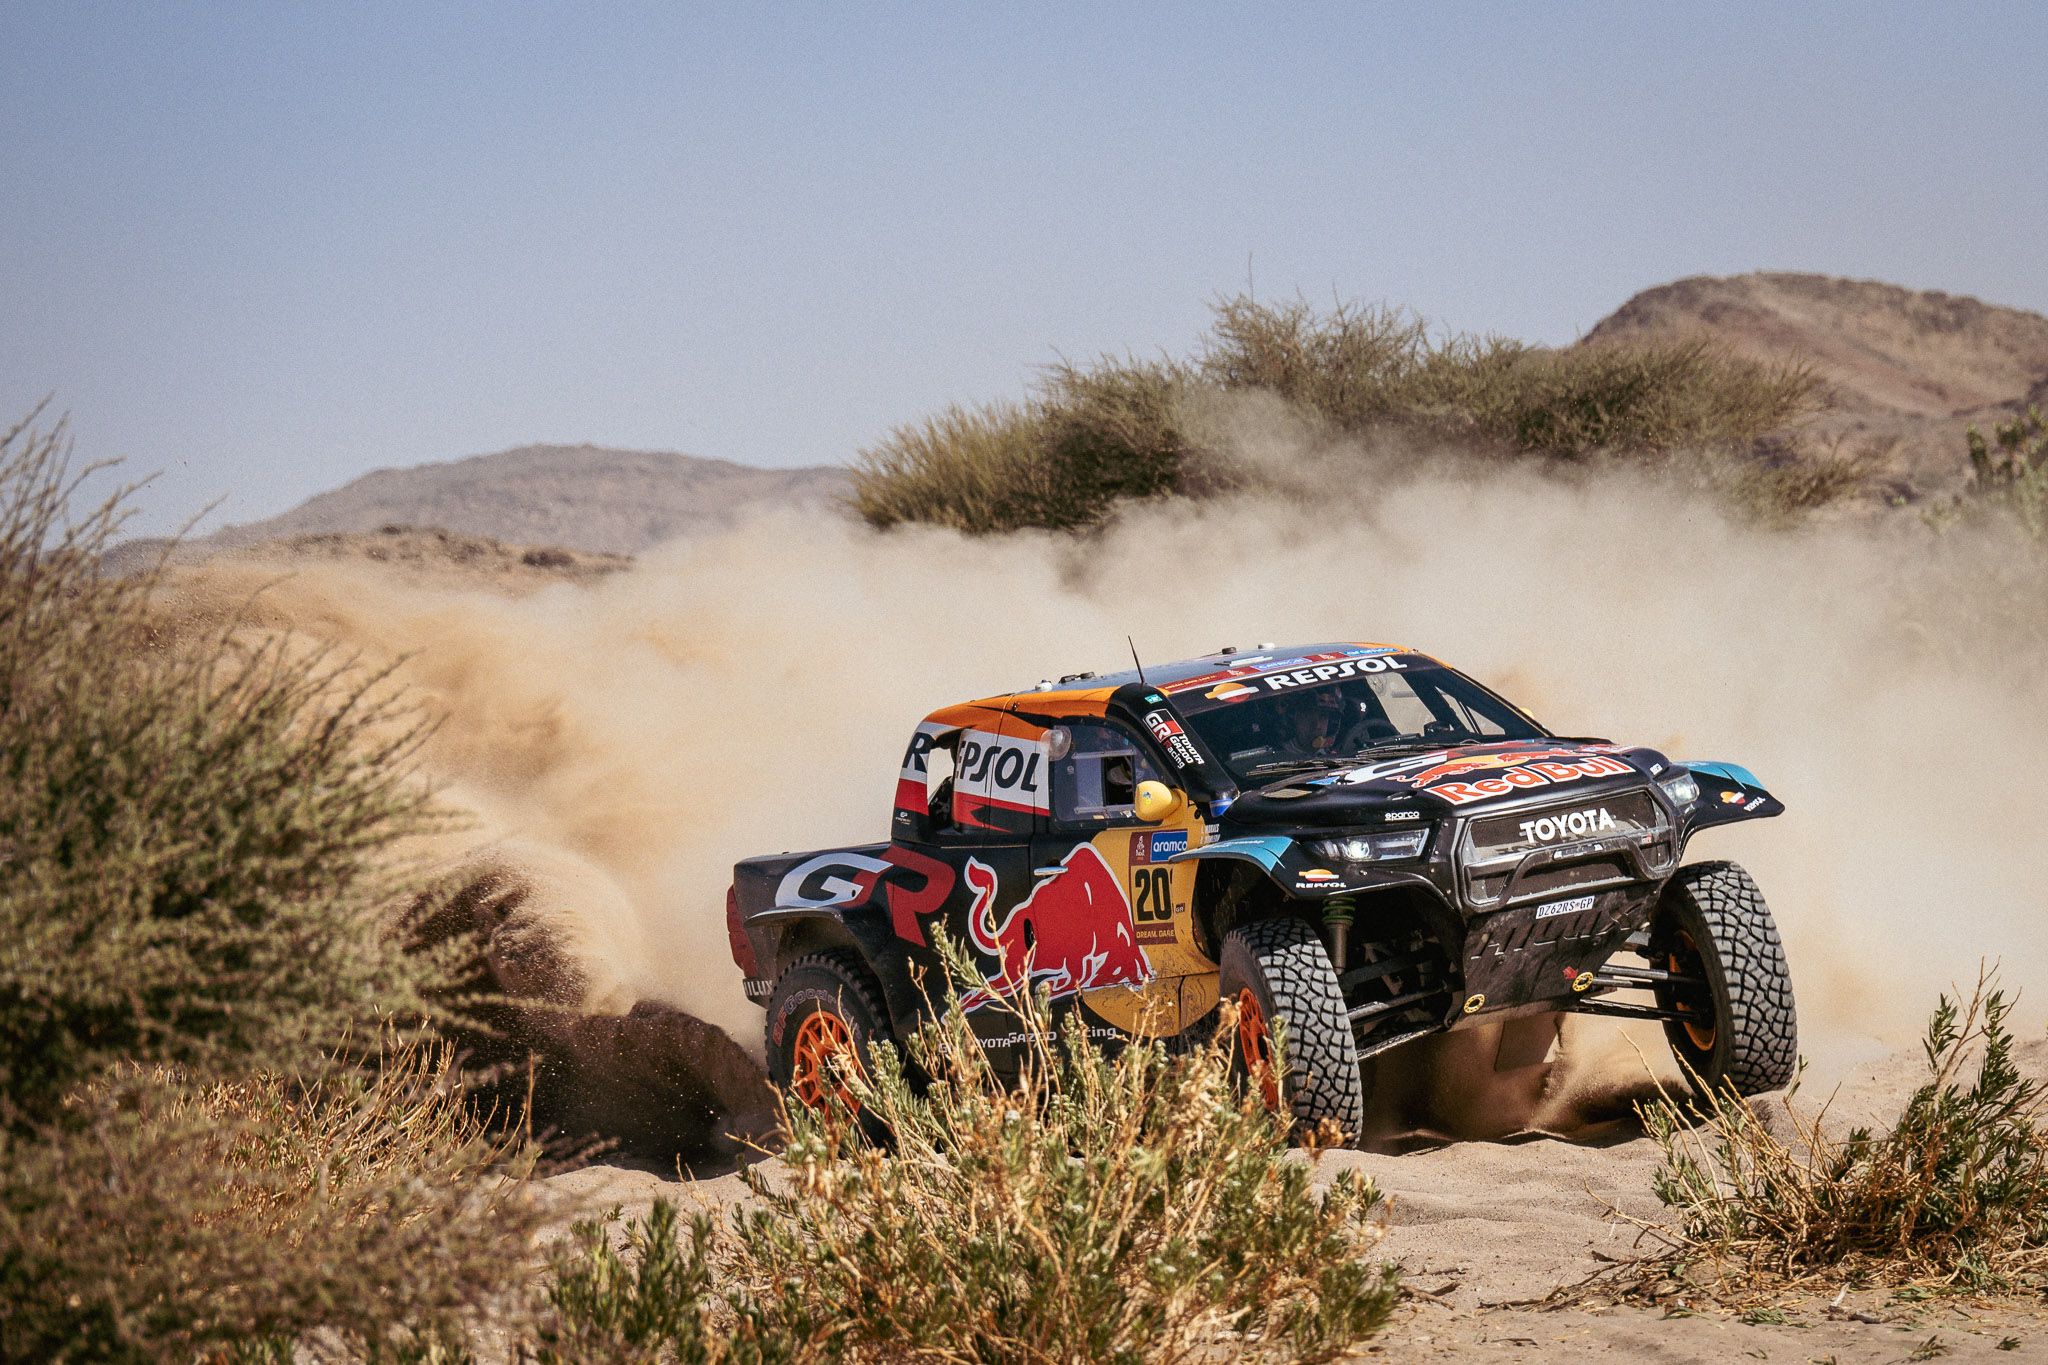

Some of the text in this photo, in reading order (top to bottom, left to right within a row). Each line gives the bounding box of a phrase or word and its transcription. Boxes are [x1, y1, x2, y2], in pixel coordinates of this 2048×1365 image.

[1263, 656, 1408, 691] REPSOL
[1145, 712, 1171, 740] GR
[1163, 739, 1186, 769] Racing
[1169, 735, 1194, 764] GAZOO
[1178, 734, 1205, 765] TOYOTA
[1423, 756, 1636, 805] Red Bull
[1518, 807, 1617, 843] TOYOTA
[1153, 841, 1188, 852] aramco
[775, 844, 957, 948] GR
[1134, 867, 1173, 922] 20
[1009, 1031, 1057, 1043] GAZO
